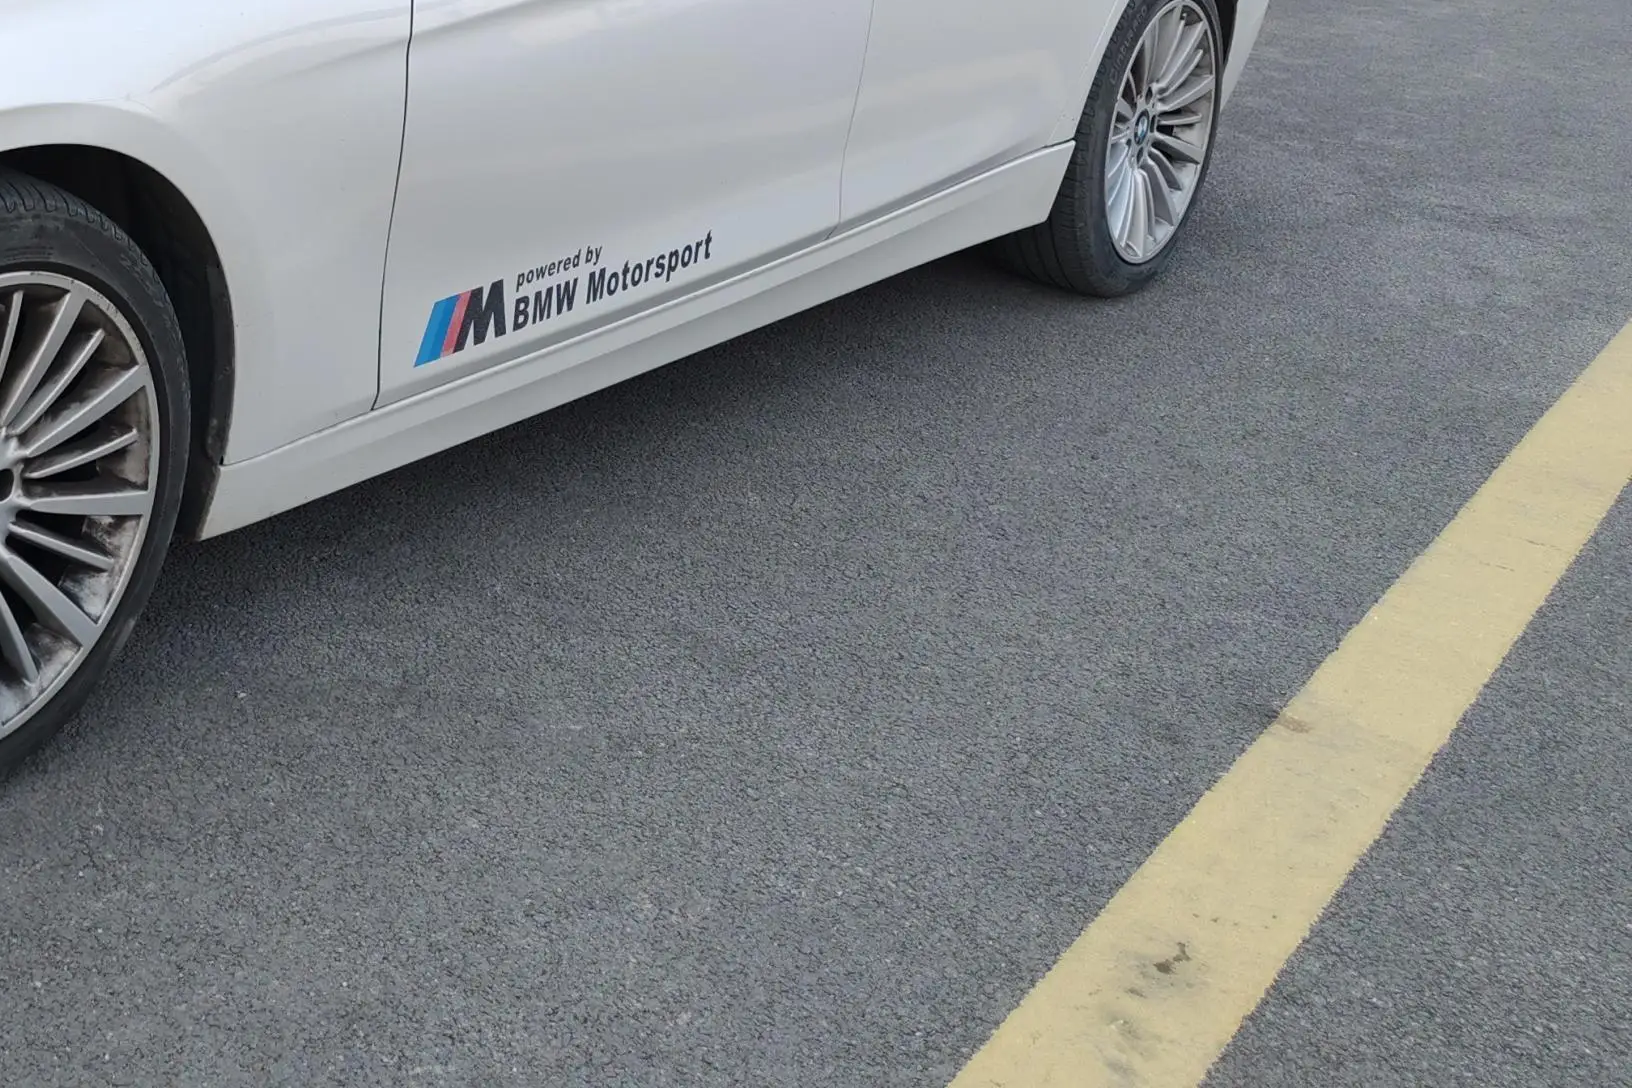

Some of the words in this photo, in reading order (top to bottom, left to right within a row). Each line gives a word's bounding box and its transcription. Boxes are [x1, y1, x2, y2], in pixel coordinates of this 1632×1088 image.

[512, 277, 579, 332] BMW
[585, 229, 713, 304] Motorsport
[516, 249, 582, 292] powered
[584, 245, 603, 264] by
